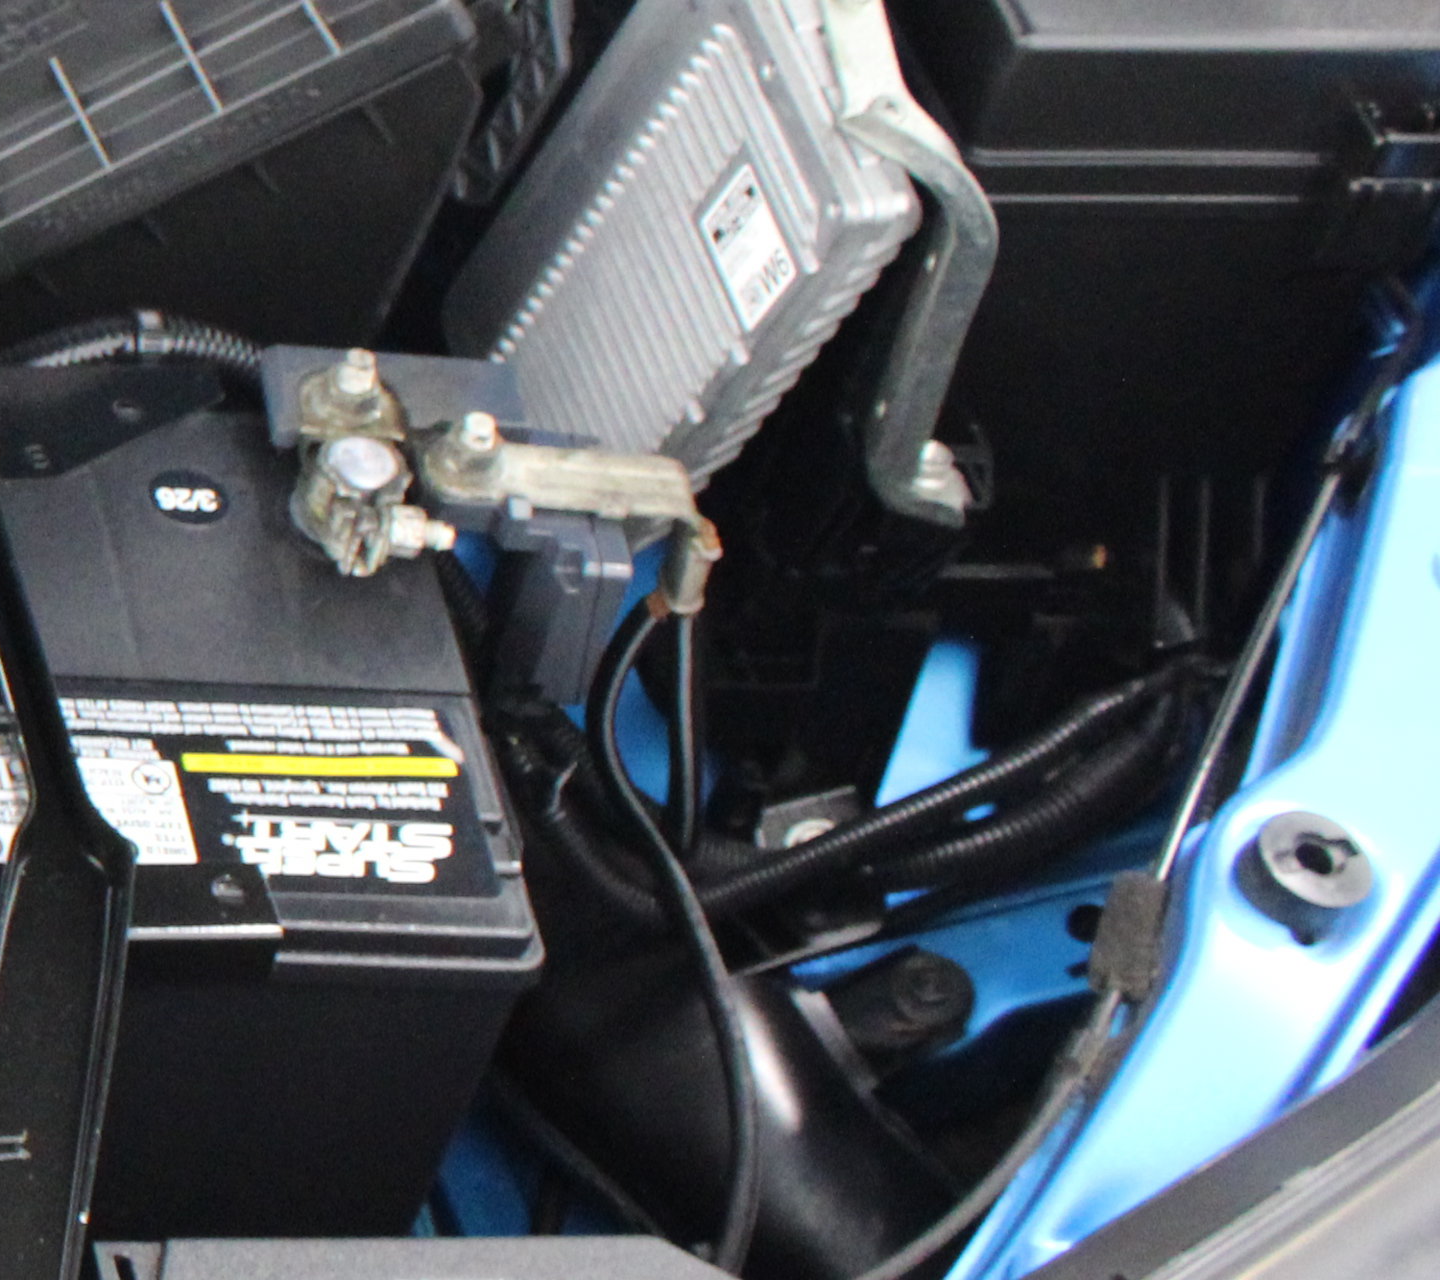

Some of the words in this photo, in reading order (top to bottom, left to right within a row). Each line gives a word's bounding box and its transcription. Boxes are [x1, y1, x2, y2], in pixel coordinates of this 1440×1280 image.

[154, 485, 221, 513] 3/26
[236, 822, 452, 862] START
[242, 846, 435, 883] SUPER
